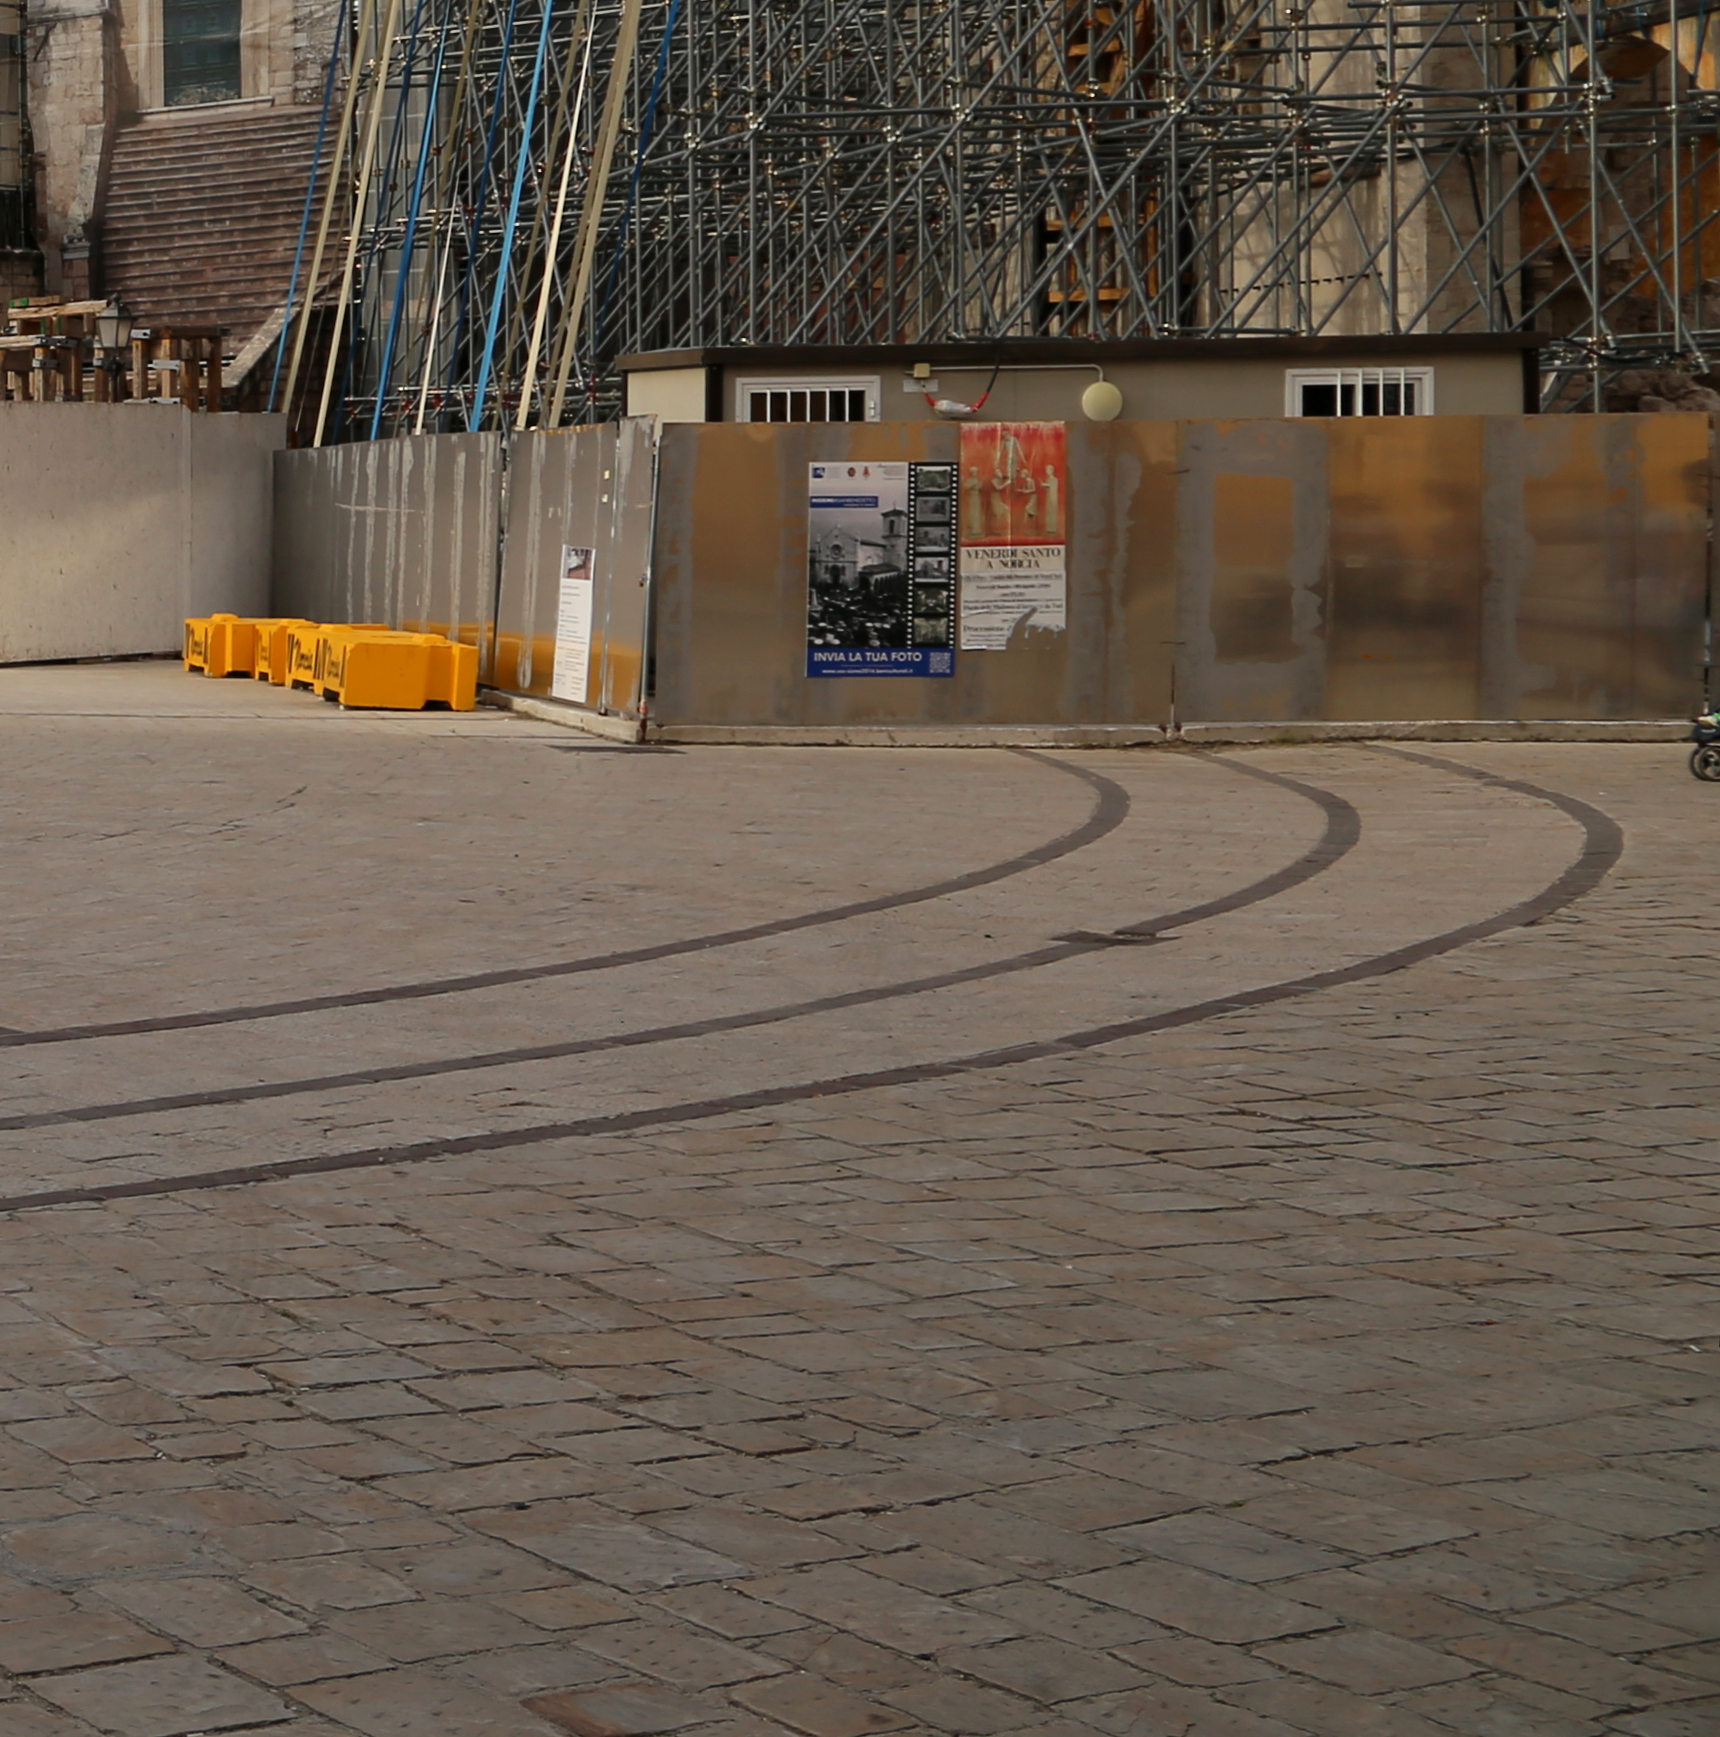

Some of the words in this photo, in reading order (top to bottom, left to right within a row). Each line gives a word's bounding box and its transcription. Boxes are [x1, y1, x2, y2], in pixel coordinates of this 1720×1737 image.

[1023, 547, 1061, 558] SANTO
[987, 560, 994, 569] A
[999, 559, 1041, 569] NORCIA
[814, 652, 846, 662] INVIA
[849, 652, 863, 662] LA
[865, 652, 888, 662] TUA
[891, 652, 923, 662] FOTO
